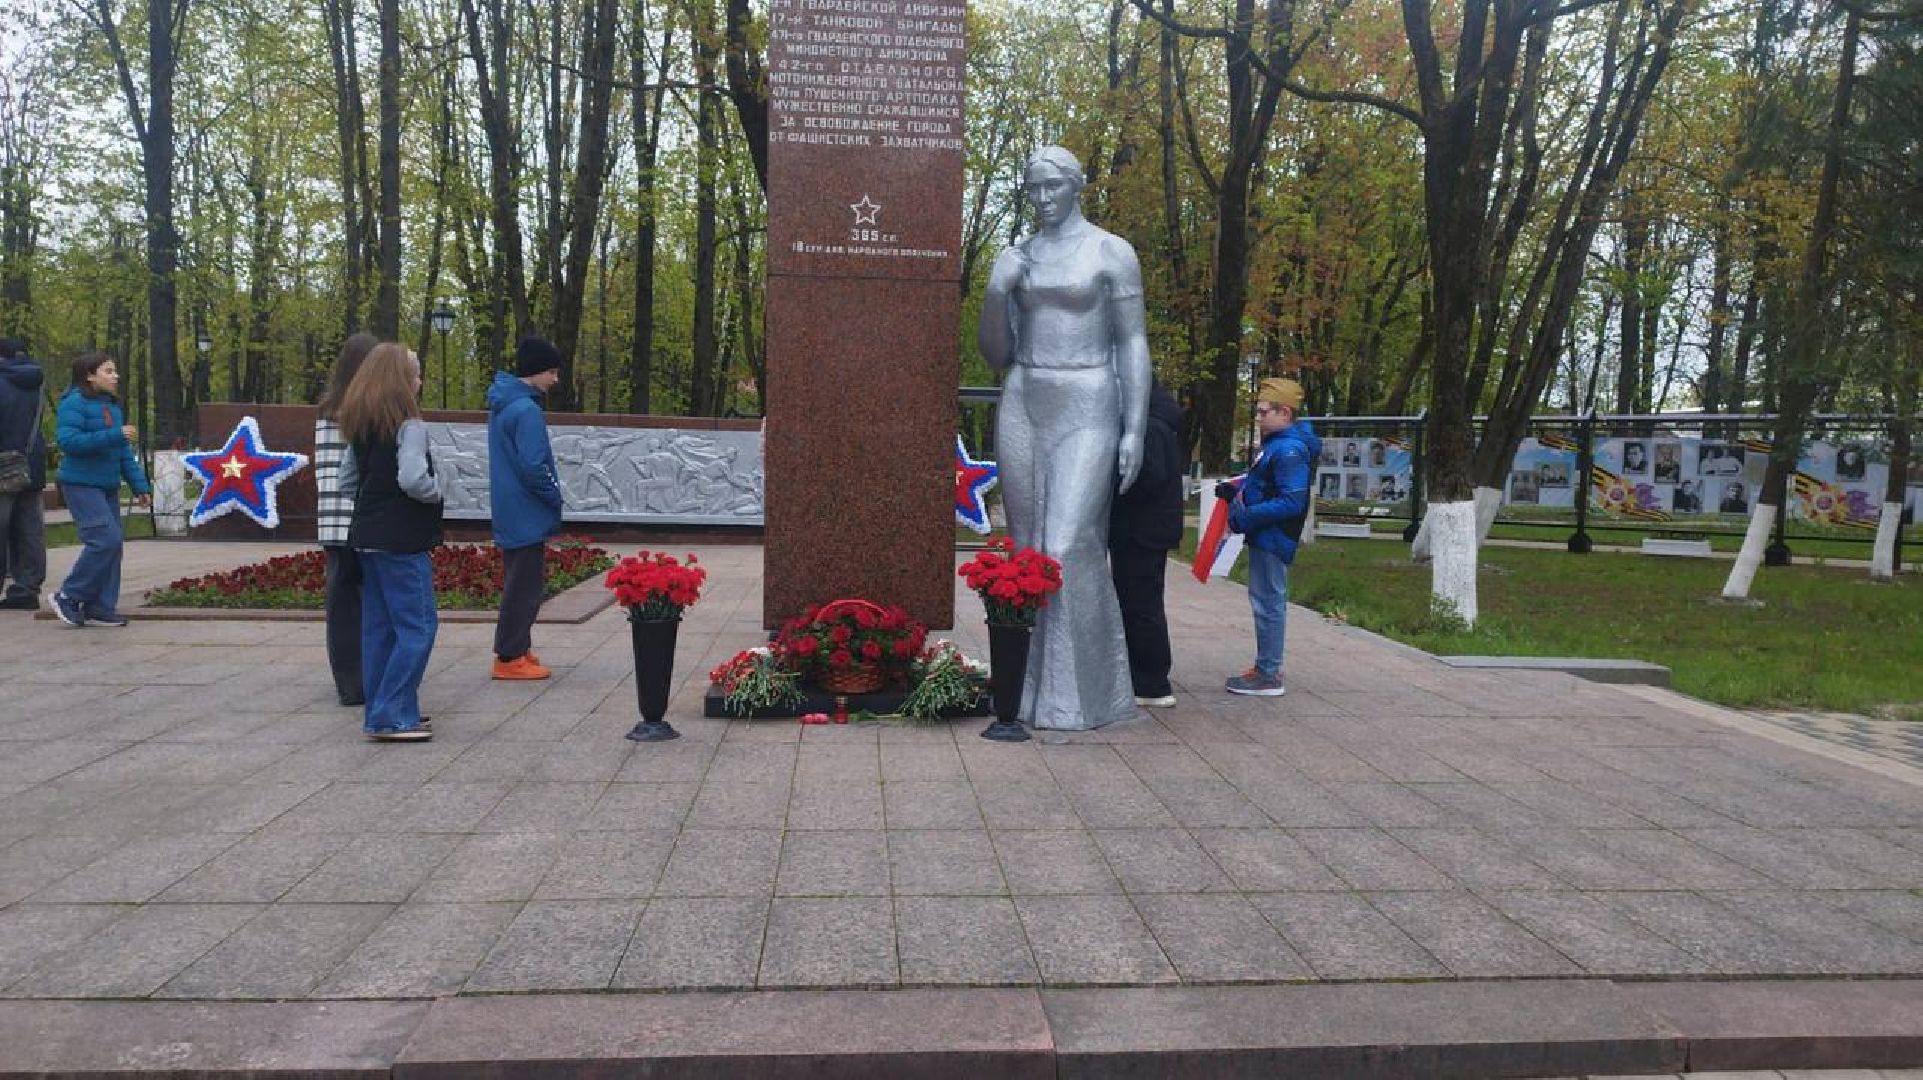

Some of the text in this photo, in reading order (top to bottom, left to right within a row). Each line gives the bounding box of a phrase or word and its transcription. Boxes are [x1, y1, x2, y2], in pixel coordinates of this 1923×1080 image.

[904, 3, 965, 17] ДИВИЗИИ
[814, 15, 883, 29] ТАНКОВОЙ
[898, 20, 963, 34] БРИГАДЫ
[895, 35, 964, 49] ОТДЕЛЬНОГО
[880, 48, 948, 61] ДИВИЗИОНА
[841, 61, 956, 78] ОТДЕЛЬНОГО
[896, 78, 964, 91] БАТАЛЬОНА
[804, 87, 879, 102] ПУШЕЧНОГО
[886, 92, 958, 106] АРТПОЛКА
[773, 99, 960, 118] МУЖЕСТВЕННО СРАЖАВШИМСЯ
[780, 115, 951, 134] ЗА ОСВОБОЖДЕНИЕ ГОРОДА
[769, 131, 962, 149] ОТ ФАШИСТСКИХ ЗАХВАТЧИКОВ
